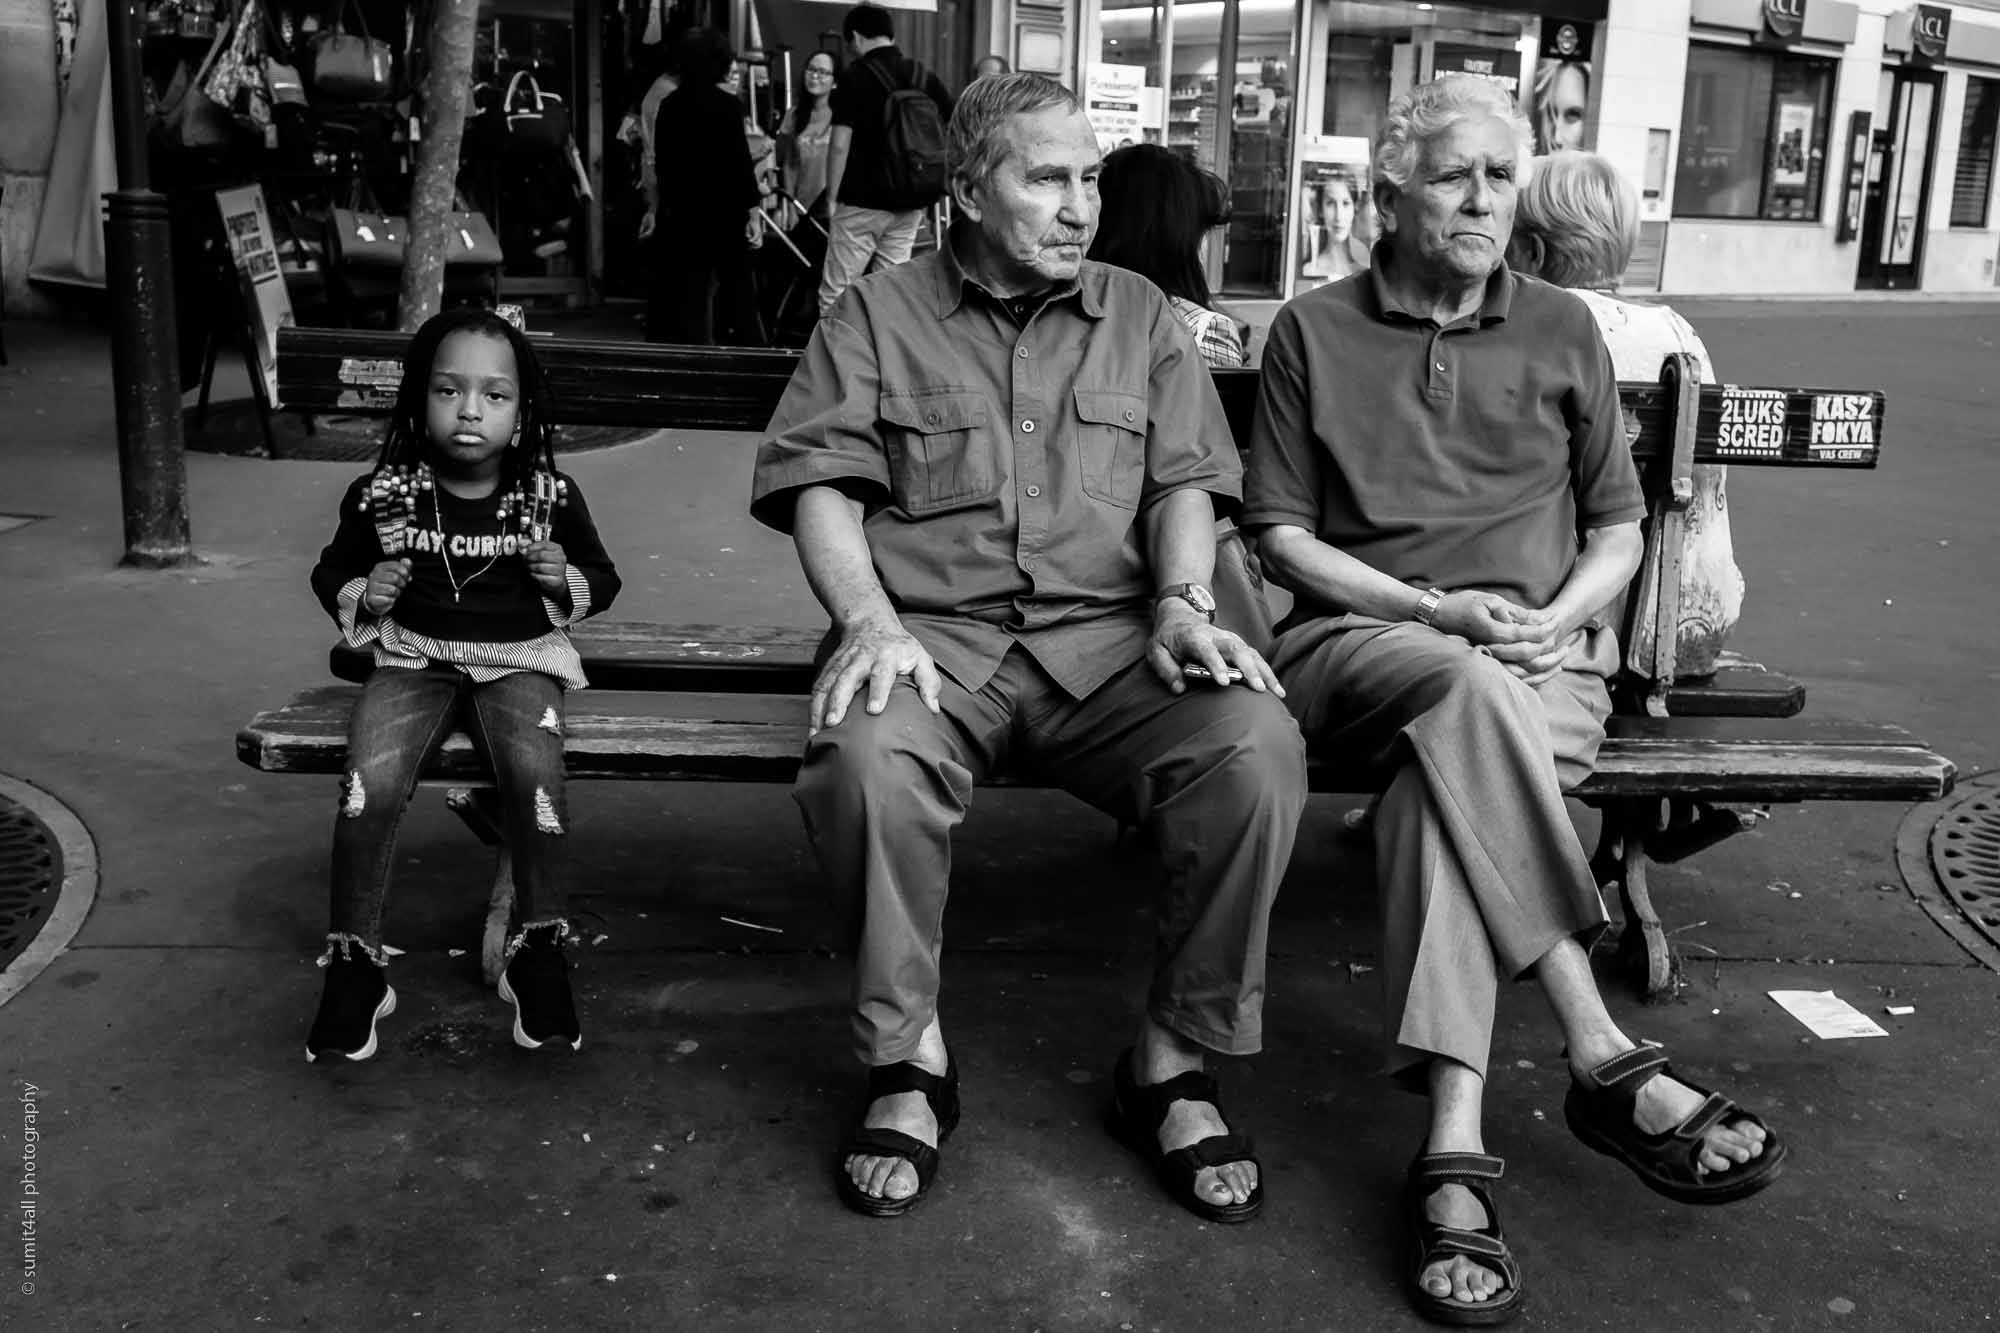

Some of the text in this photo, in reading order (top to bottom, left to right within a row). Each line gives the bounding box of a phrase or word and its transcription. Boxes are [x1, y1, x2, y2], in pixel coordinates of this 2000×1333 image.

[1919, 15, 1945, 38] LCL
[1720, 399, 1785, 424] 2LUKS
[1815, 395, 1873, 421] KAS2
[1717, 423, 1783, 449] SCRED
[1811, 421, 1874, 444] FOKYA
[1837, 449, 1863, 460] CREW
[404, 526, 445, 554] TAY
